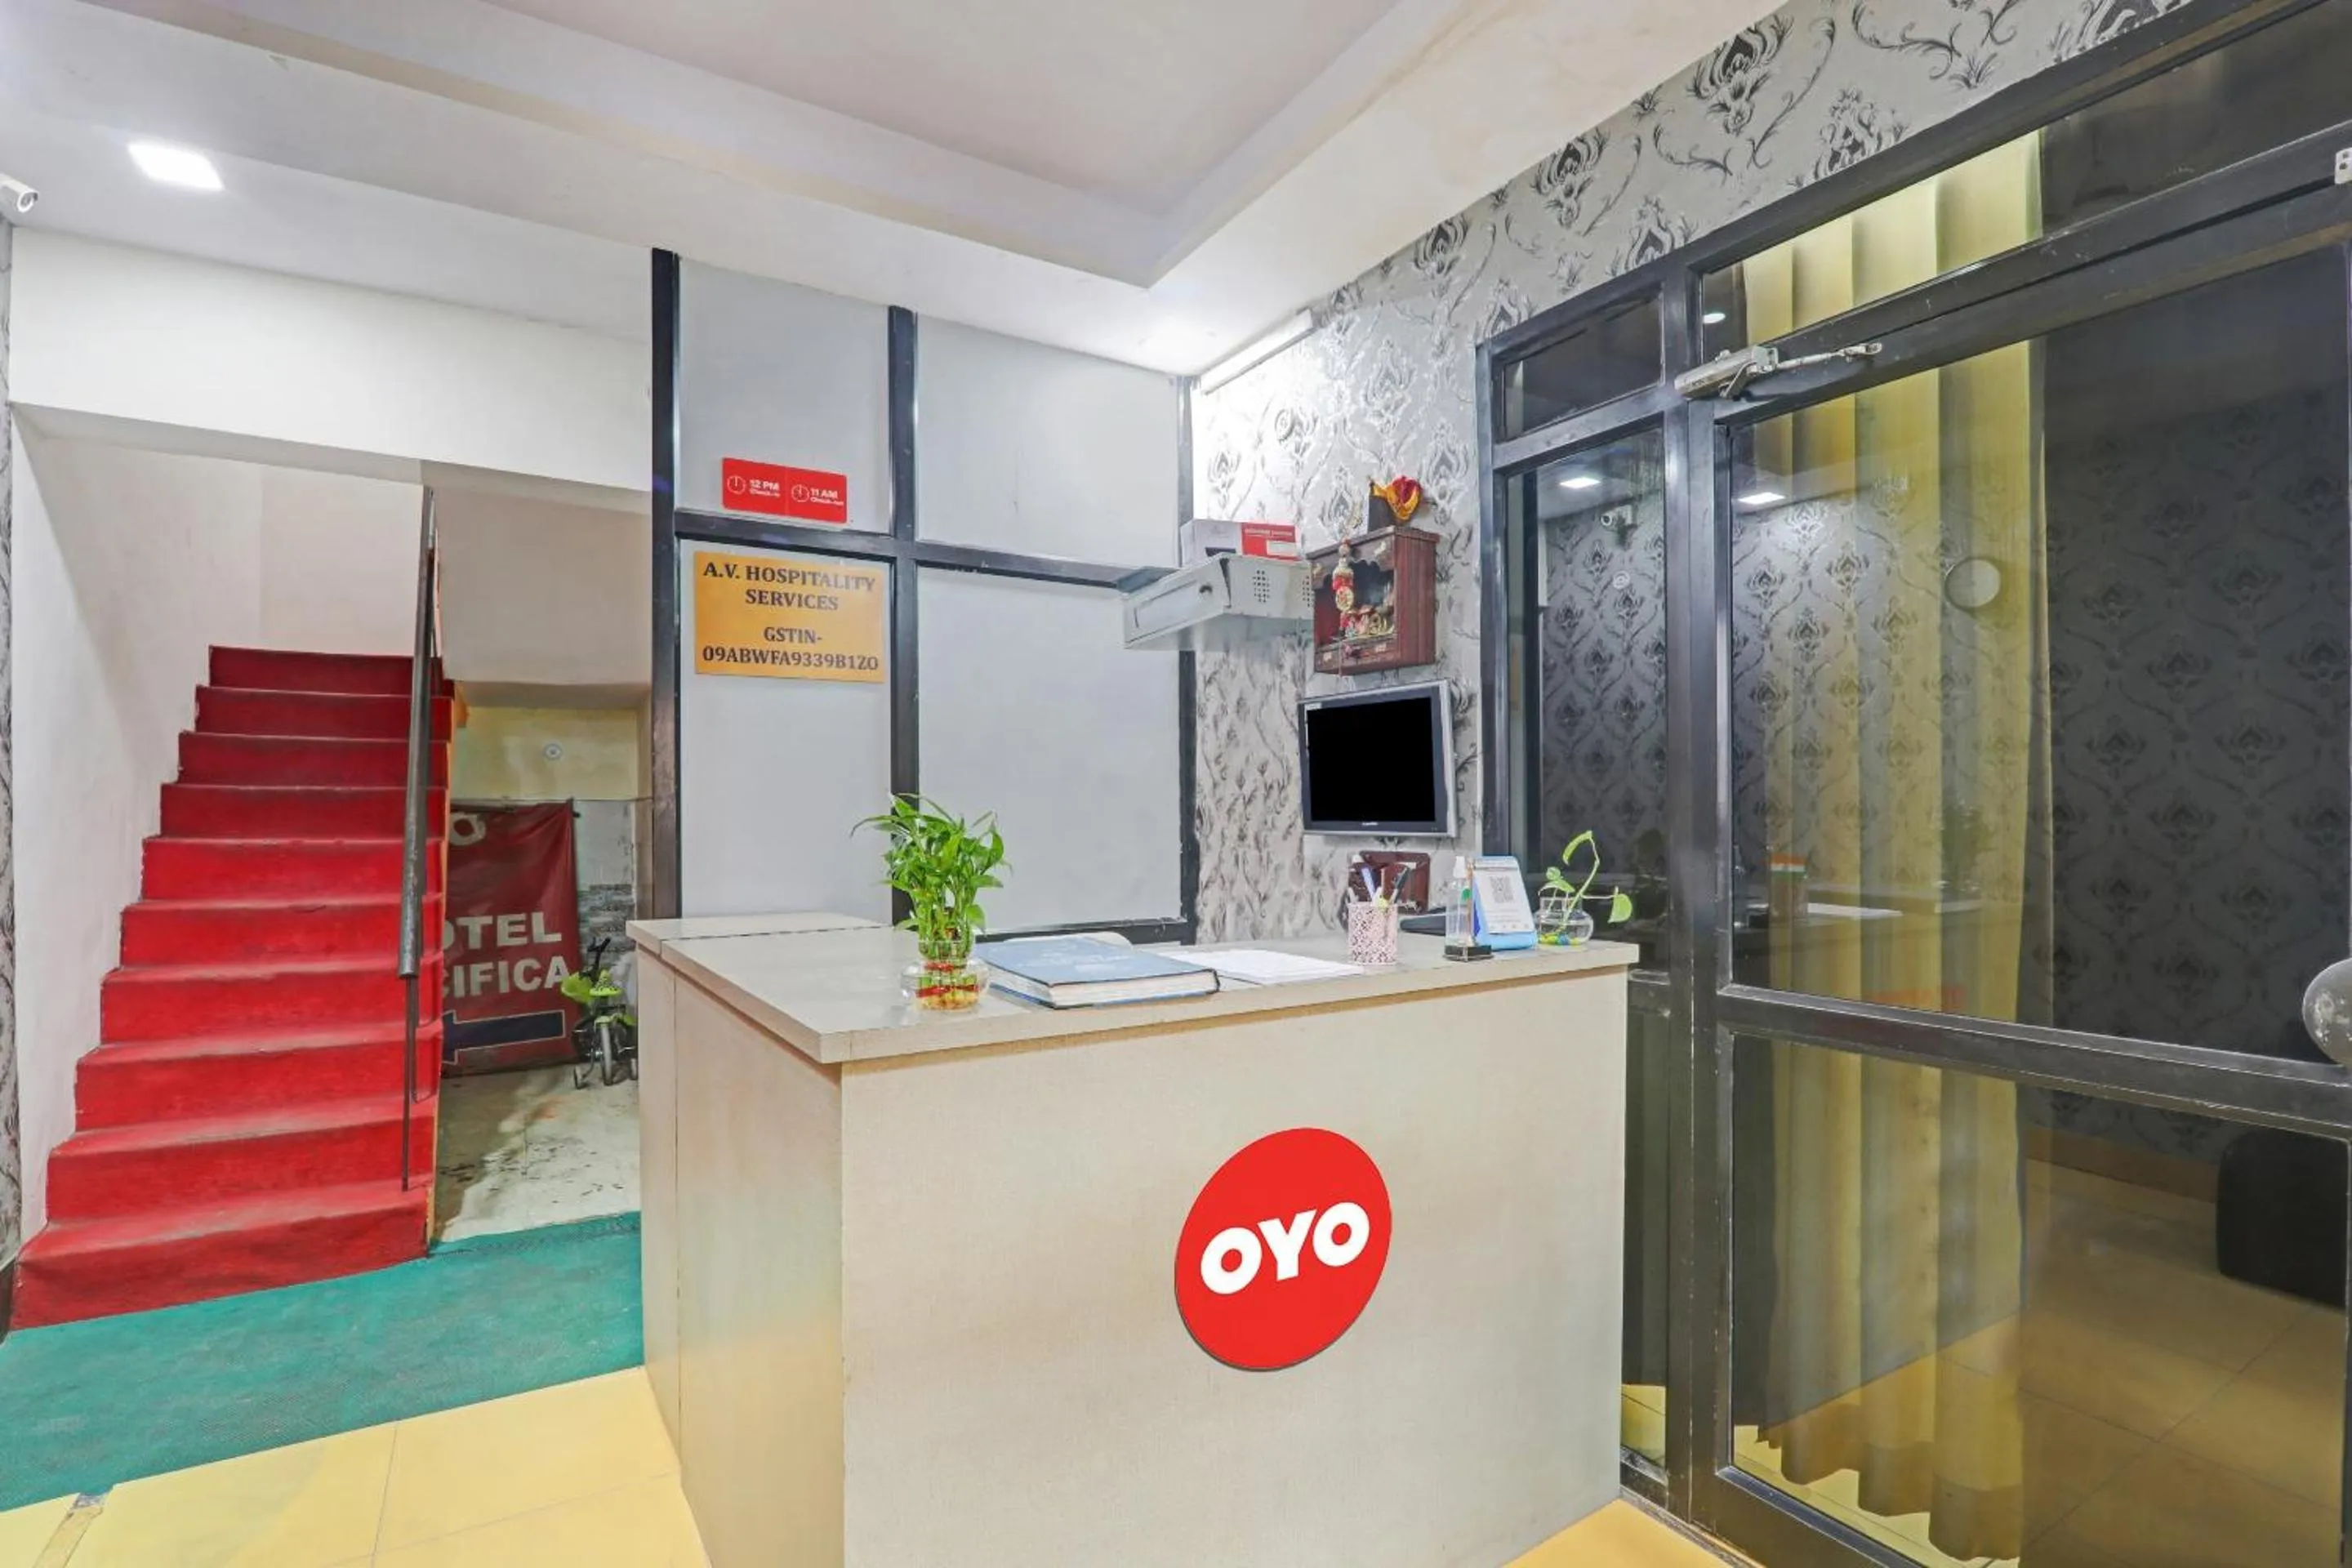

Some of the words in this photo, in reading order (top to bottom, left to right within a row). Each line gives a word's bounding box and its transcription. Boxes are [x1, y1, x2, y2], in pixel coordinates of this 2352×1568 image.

[750, 479, 761, 488] 12
[763, 480, 780, 491] PM
[821, 490, 838, 500] AM
[703, 561, 740, 579] A.V.
[745, 565, 875, 591] HOSPITALITY
[745, 589, 839, 611] SERVICES
[764, 626, 822, 644] GSTIN-
[1200, 1201, 1370, 1295] OYO
